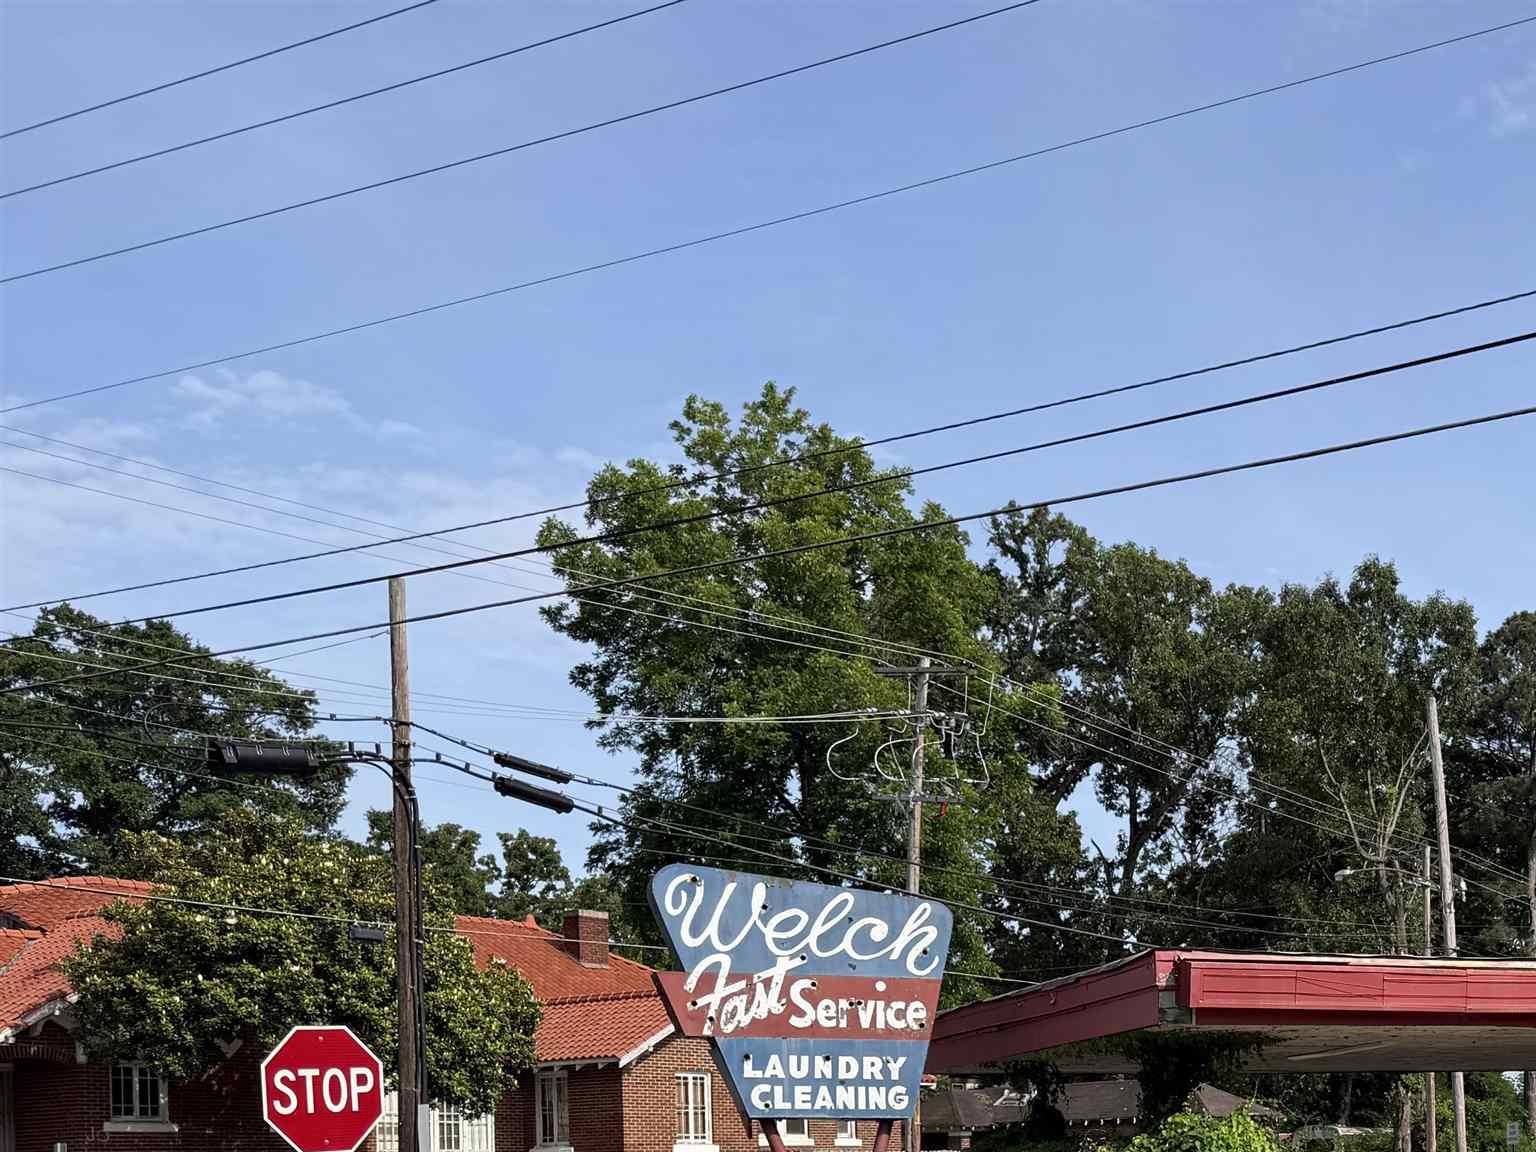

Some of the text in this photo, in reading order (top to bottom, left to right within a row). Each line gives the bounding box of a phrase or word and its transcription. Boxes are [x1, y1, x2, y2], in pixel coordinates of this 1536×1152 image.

[665, 873, 939, 976] Welch
[684, 953, 927, 1035] Fast Service
[743, 1053, 906, 1080] LAUNDRY
[273, 1067, 374, 1115] STOP
[751, 1083, 909, 1111] CLEANING
